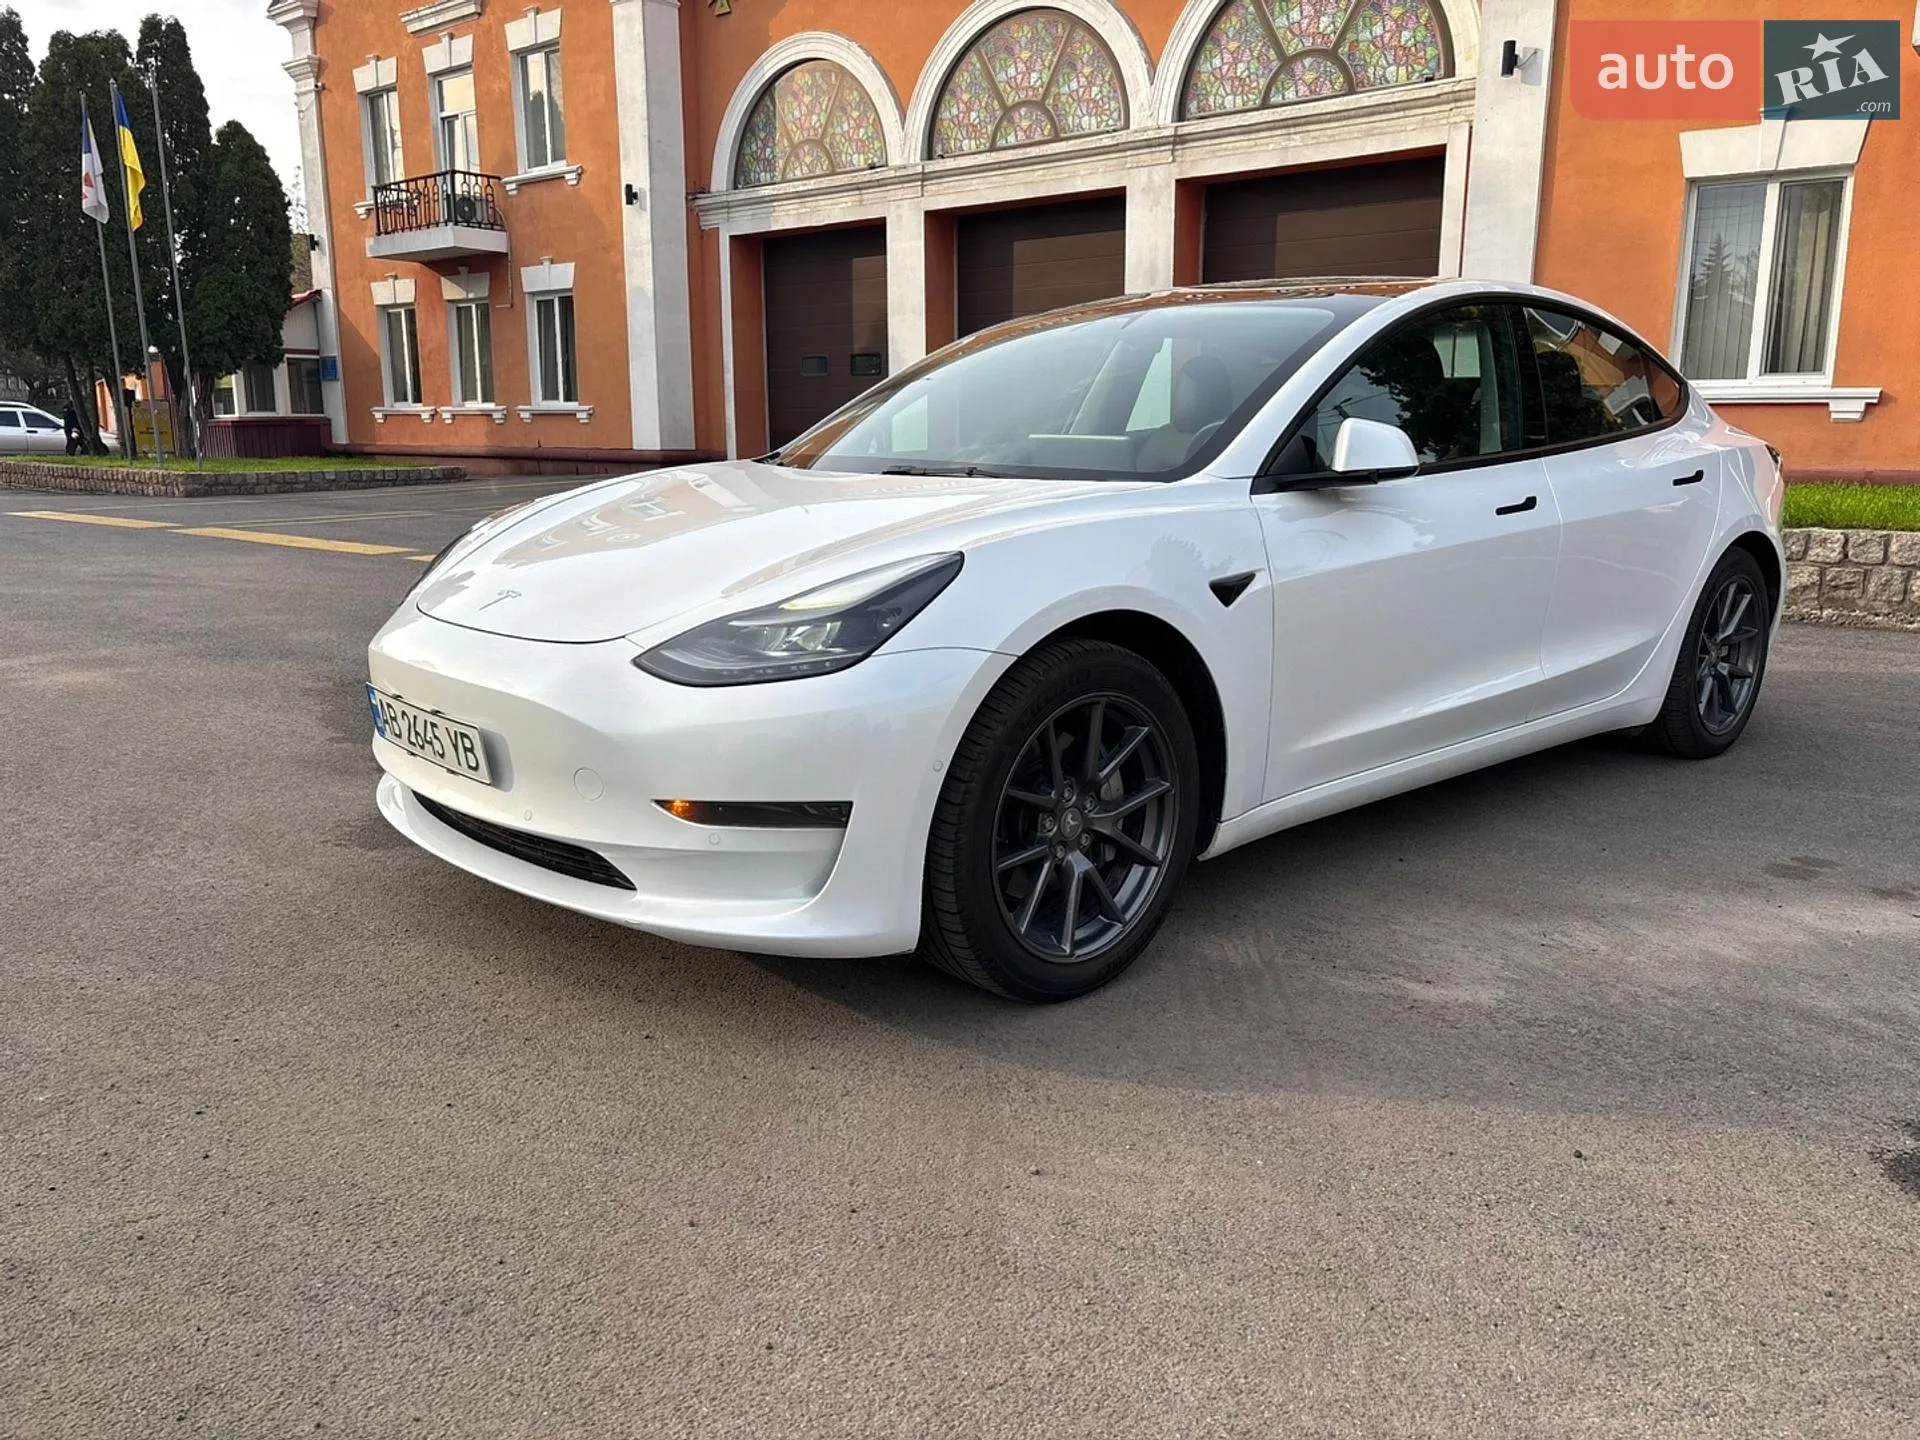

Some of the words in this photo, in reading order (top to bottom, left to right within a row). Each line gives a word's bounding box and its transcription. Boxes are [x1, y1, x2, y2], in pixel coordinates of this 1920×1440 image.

[379, 698, 402, 739] AB
[401, 709, 445, 759] 2645
[445, 726, 479, 772] YB
